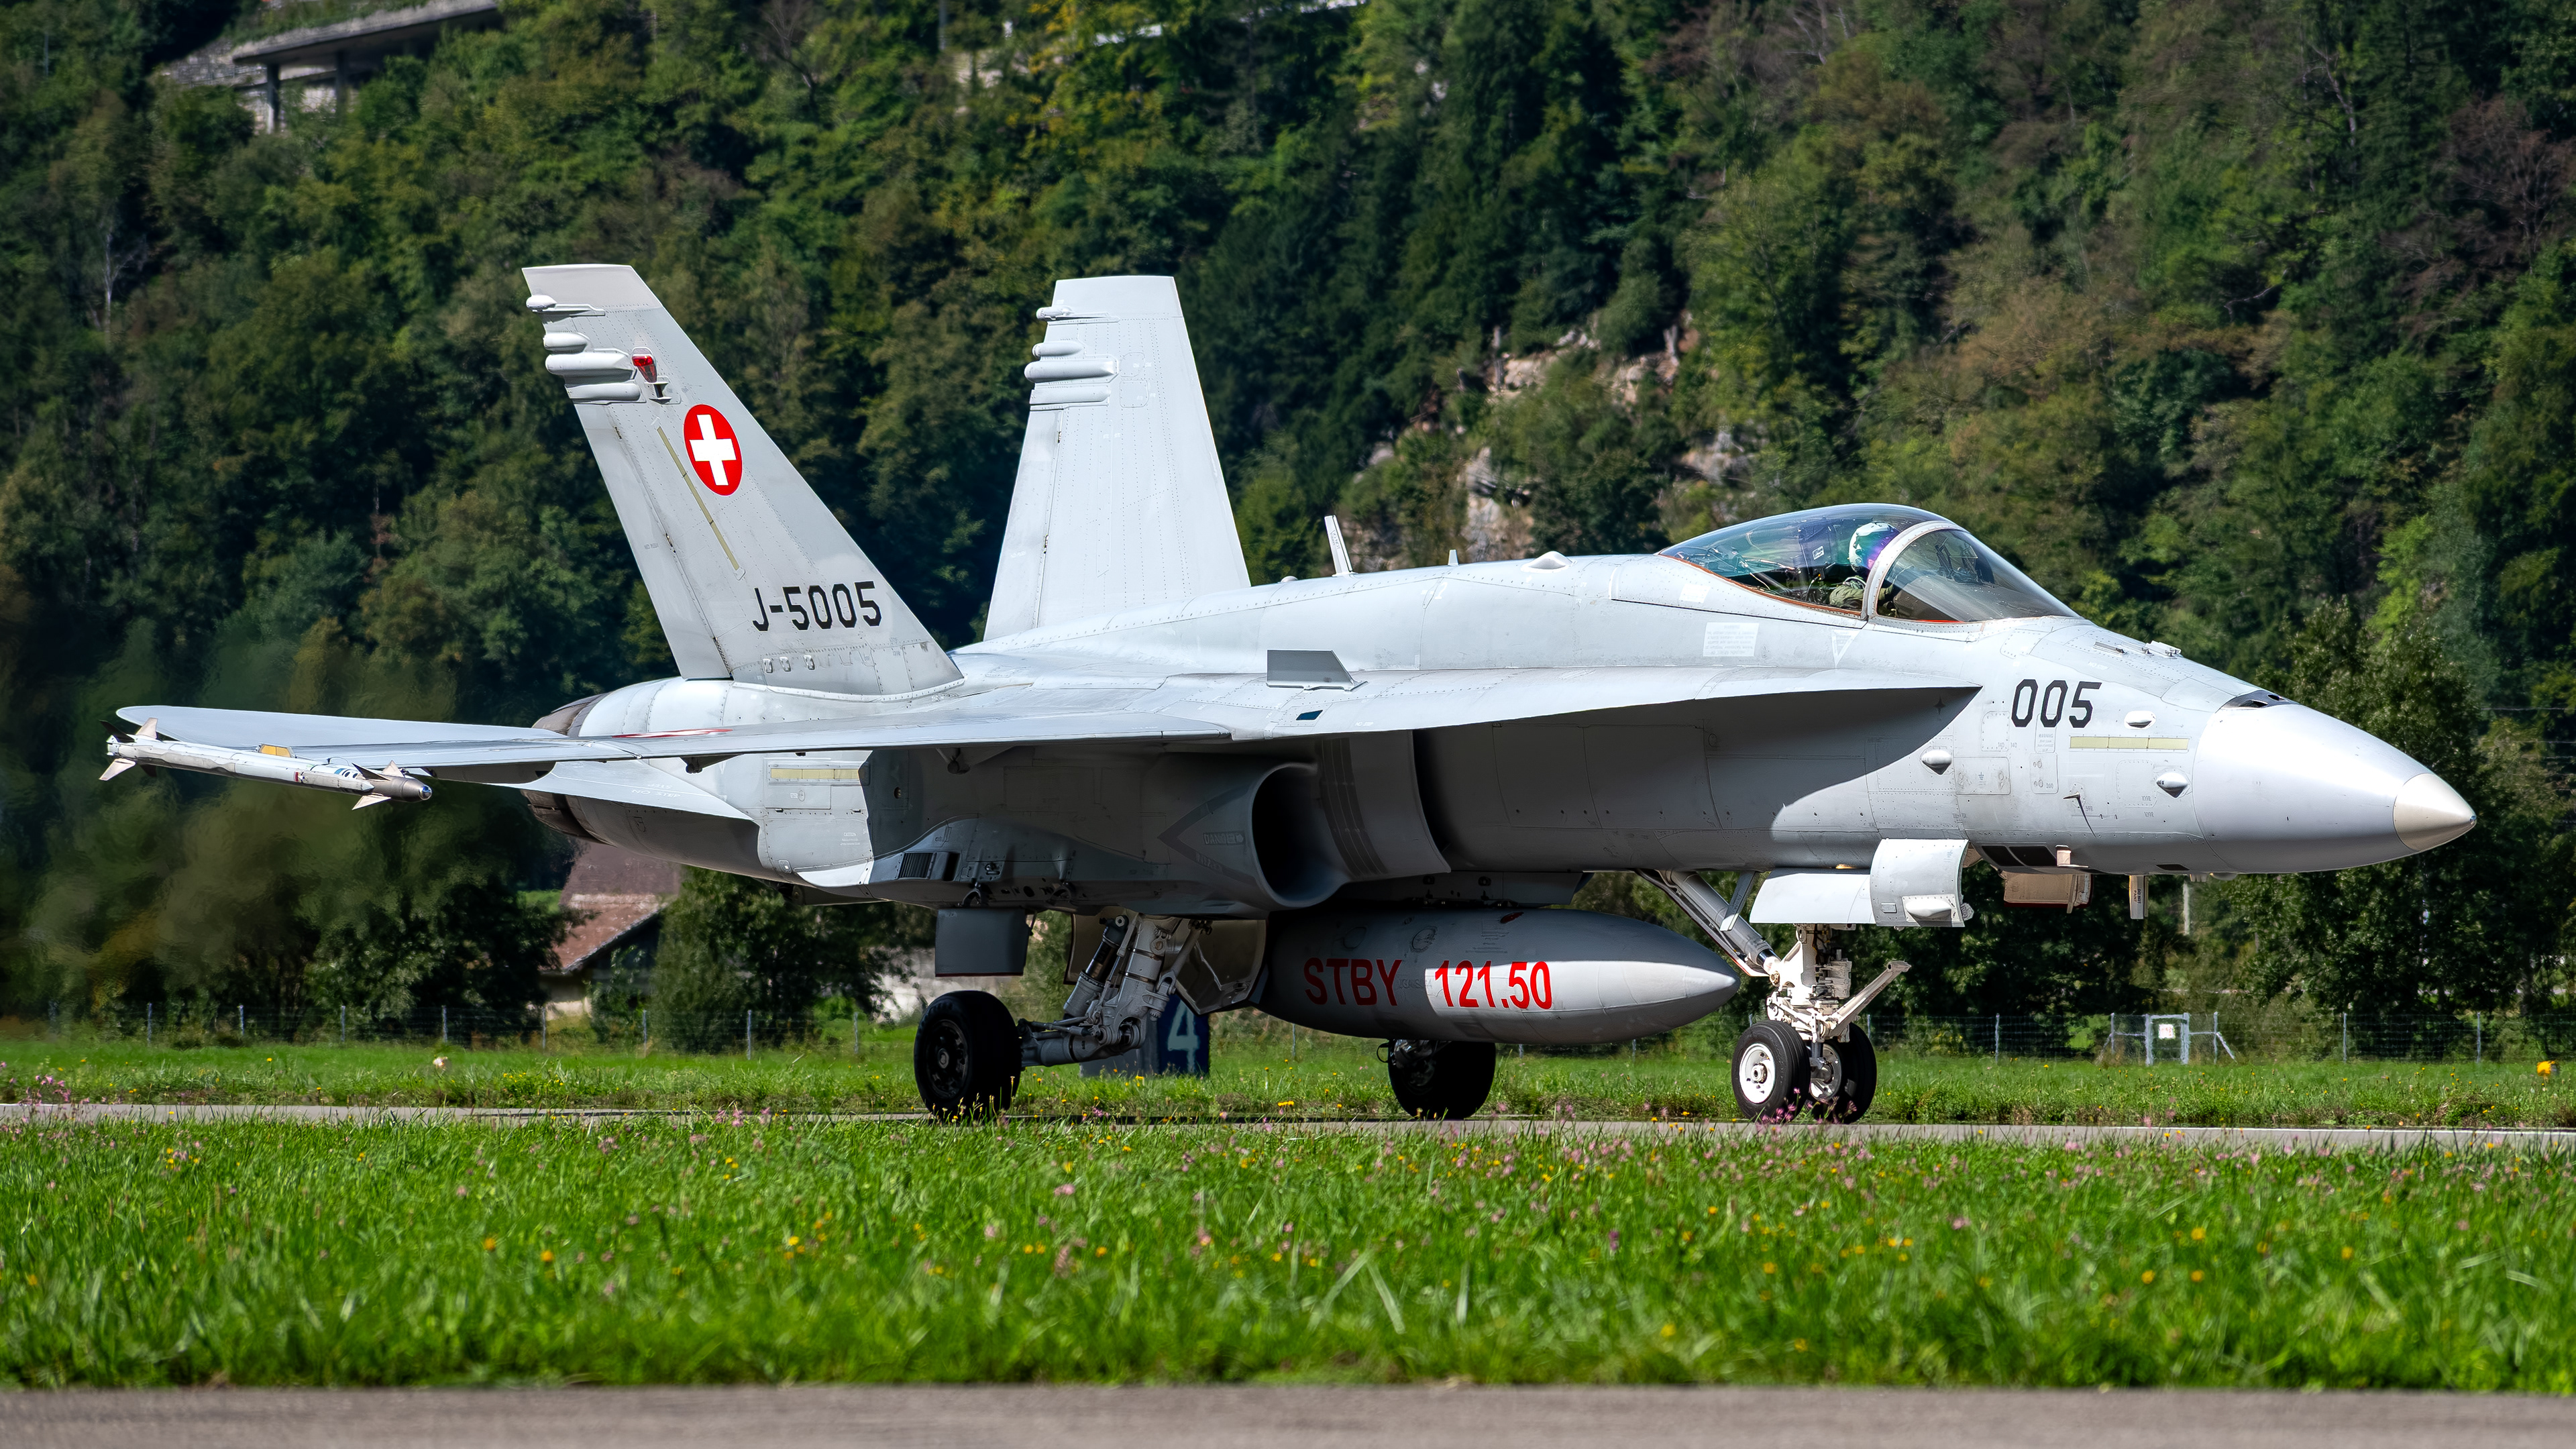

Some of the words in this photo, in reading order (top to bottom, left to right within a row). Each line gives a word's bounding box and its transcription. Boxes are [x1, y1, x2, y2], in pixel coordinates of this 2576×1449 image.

[752, 581, 882, 632] J-5005
[2011, 678, 2102, 728] 005
[1303, 957, 1403, 1007] STBY
[1434, 960, 1553, 1010] 121.50
[1167, 1000, 1199, 1073] 4
